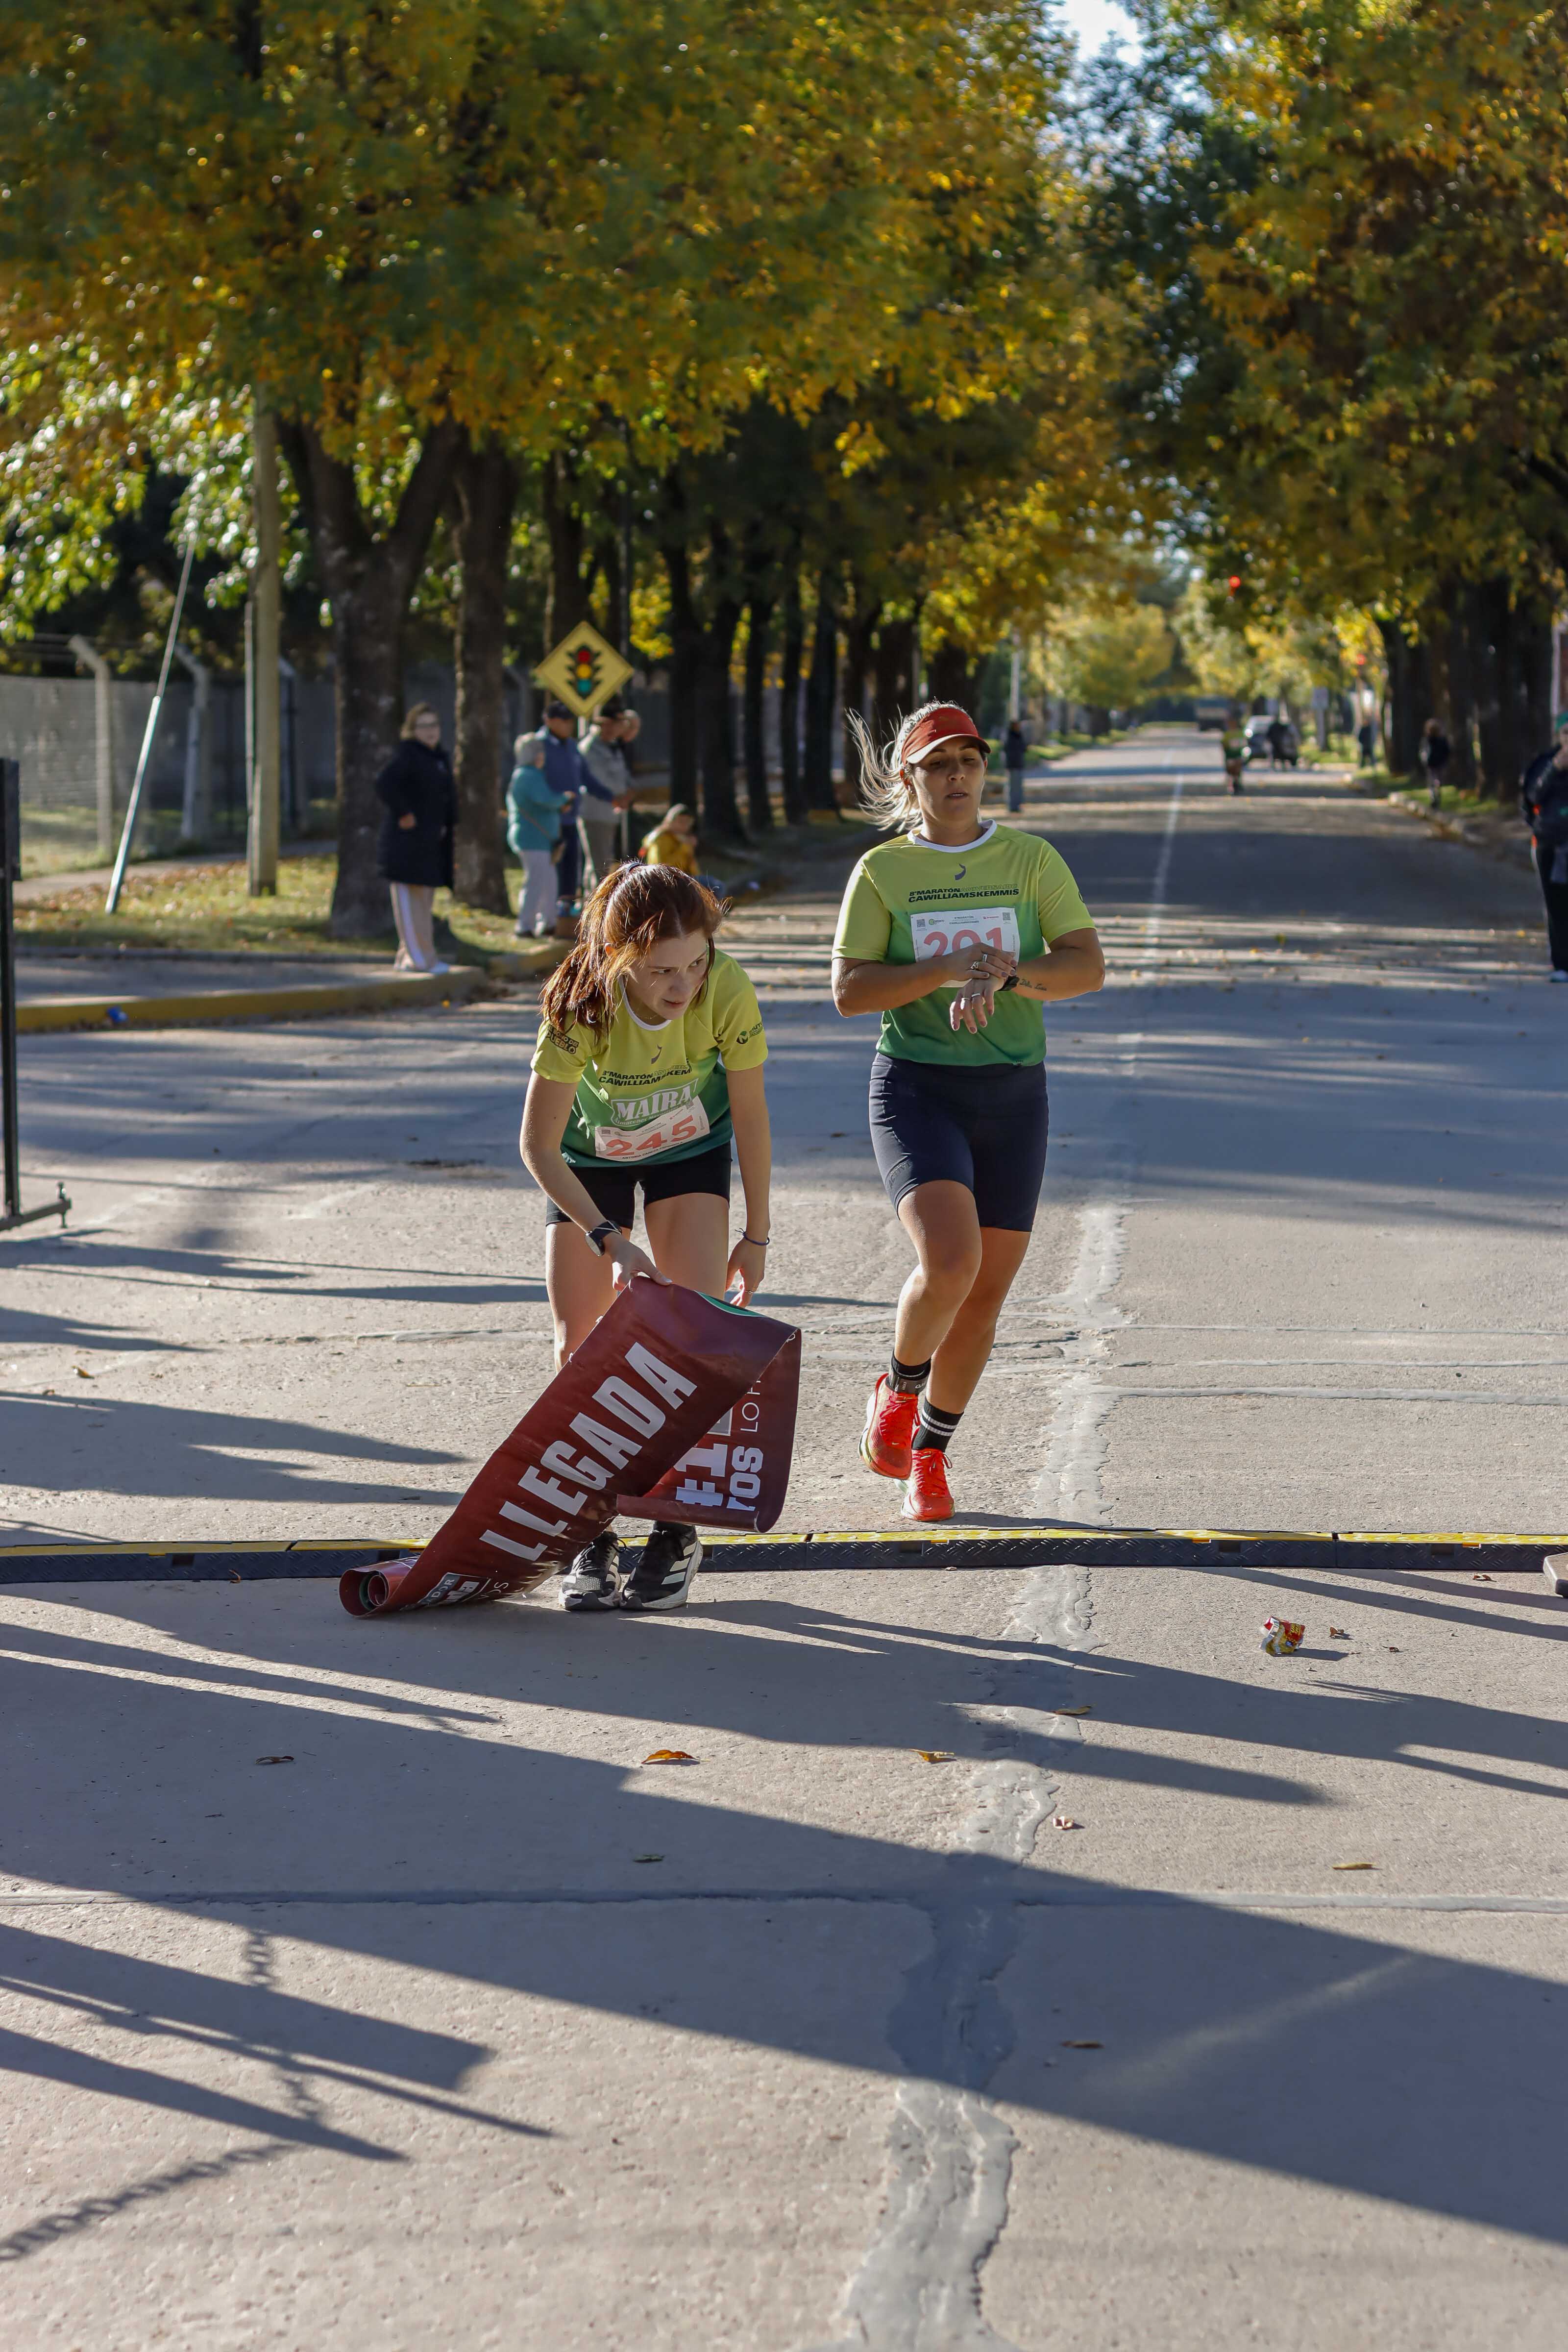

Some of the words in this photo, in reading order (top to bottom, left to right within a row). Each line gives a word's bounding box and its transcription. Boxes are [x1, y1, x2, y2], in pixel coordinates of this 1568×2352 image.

[908, 888, 1020, 903] CAWILLIAMSKEMMIS
[924, 927, 1003, 956] 201
[616, 1085, 692, 1121] MAIRA
[606, 1114, 697, 1156] 245
[479, 1342, 697, 1561] LLEGADA
